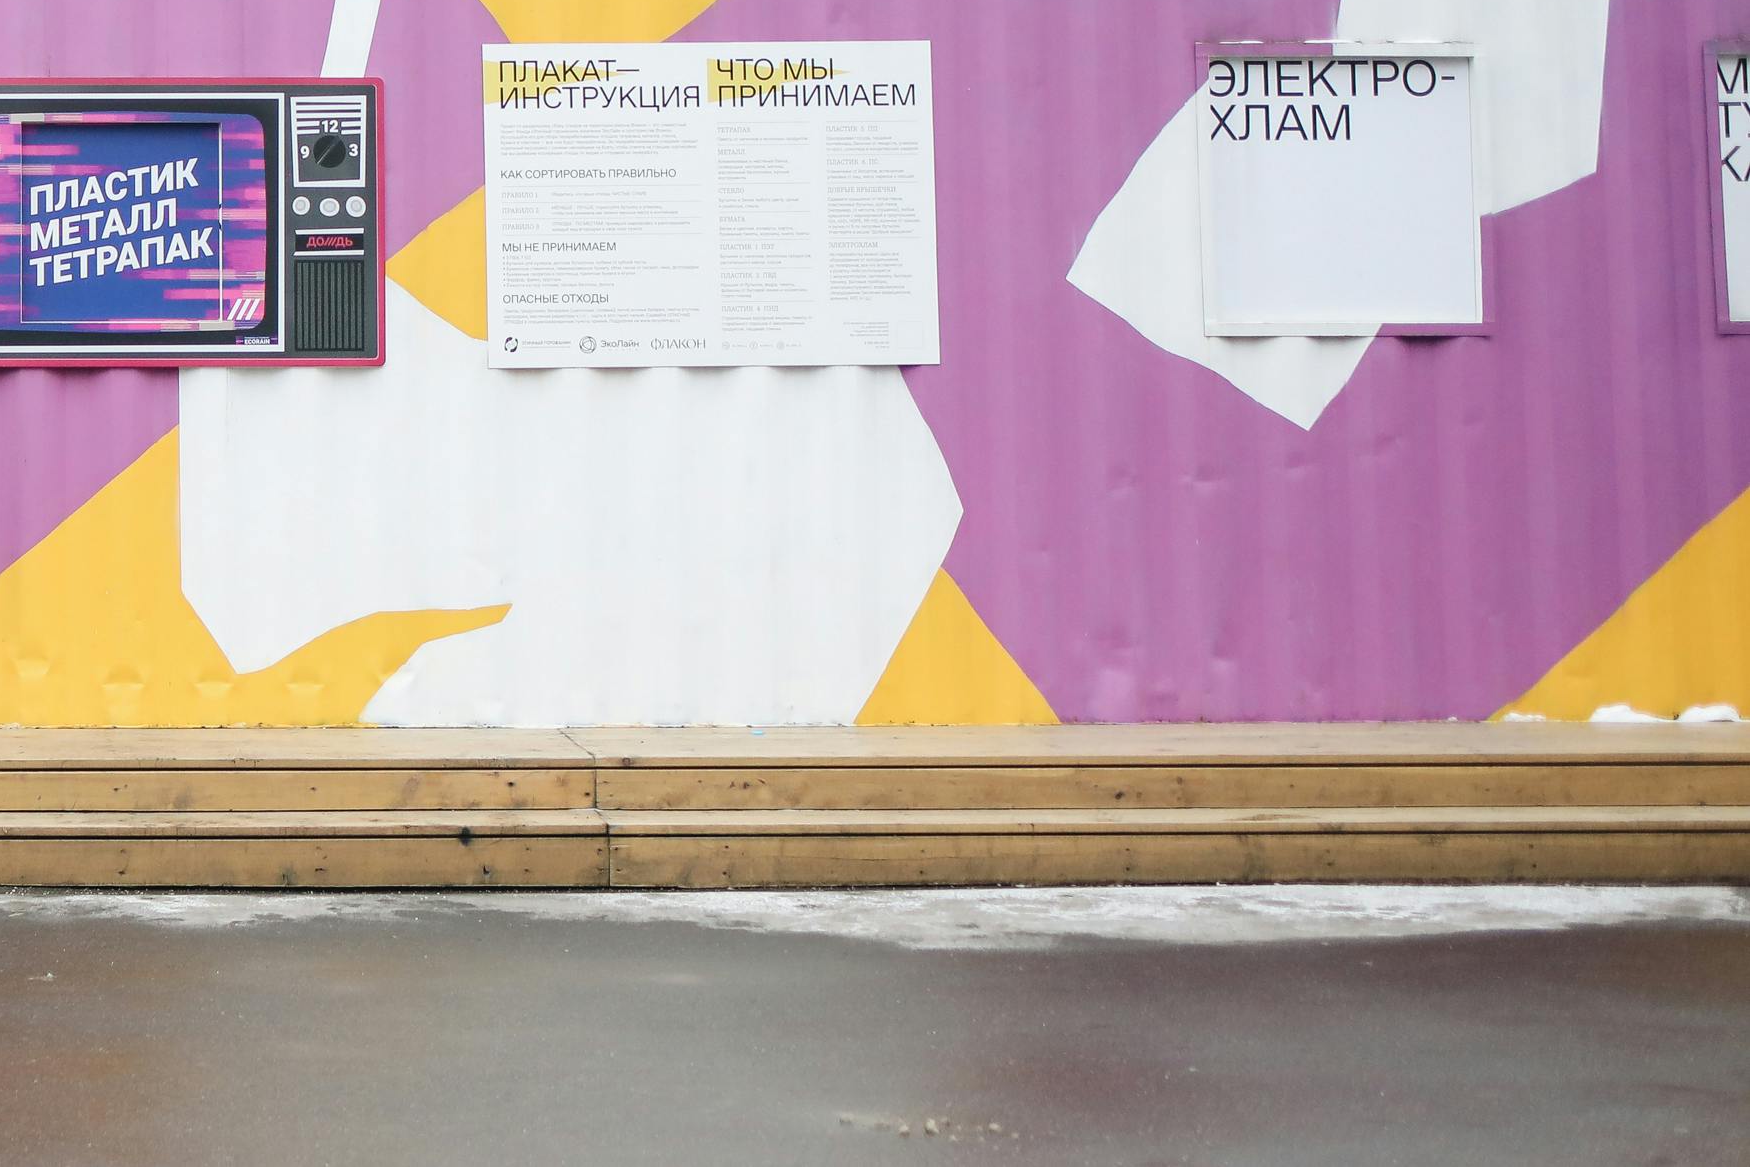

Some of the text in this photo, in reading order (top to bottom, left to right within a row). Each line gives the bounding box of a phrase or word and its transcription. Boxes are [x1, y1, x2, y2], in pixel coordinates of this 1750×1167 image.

[716, 57, 834, 81] ЧТО МЫ
[1209, 59, 1455, 98] ЭЛЕКТРО-
[499, 86, 700, 112] ИНСТРУКЦИЯ
[718, 84, 916, 107] ПРИНИМАЕМ
[321, 120, 339, 133] 12
[1210, 104, 1351, 141] ХЛАМ
[300, 145, 310, 159] 9
[348, 143, 359, 157] 3
[500, 168, 677, 179] КАК СОРТИРОВАТЬ ПРАВИЛЬНО
[30, 157, 199, 216] ПЛАСТИК
[30, 197, 177, 252] МЕТАЛЛ
[502, 242, 617, 252] МЫ НЕ ПРИНИМАЕМ
[29, 226, 214, 287] ТЕТРАПАК
[502, 294, 609, 305] ОПАСНЫЕ ОТХОДЫ
[600, 339, 639, 348] ЭкоЛайн
[650, 338, 706, 351] ФЛАКОН
